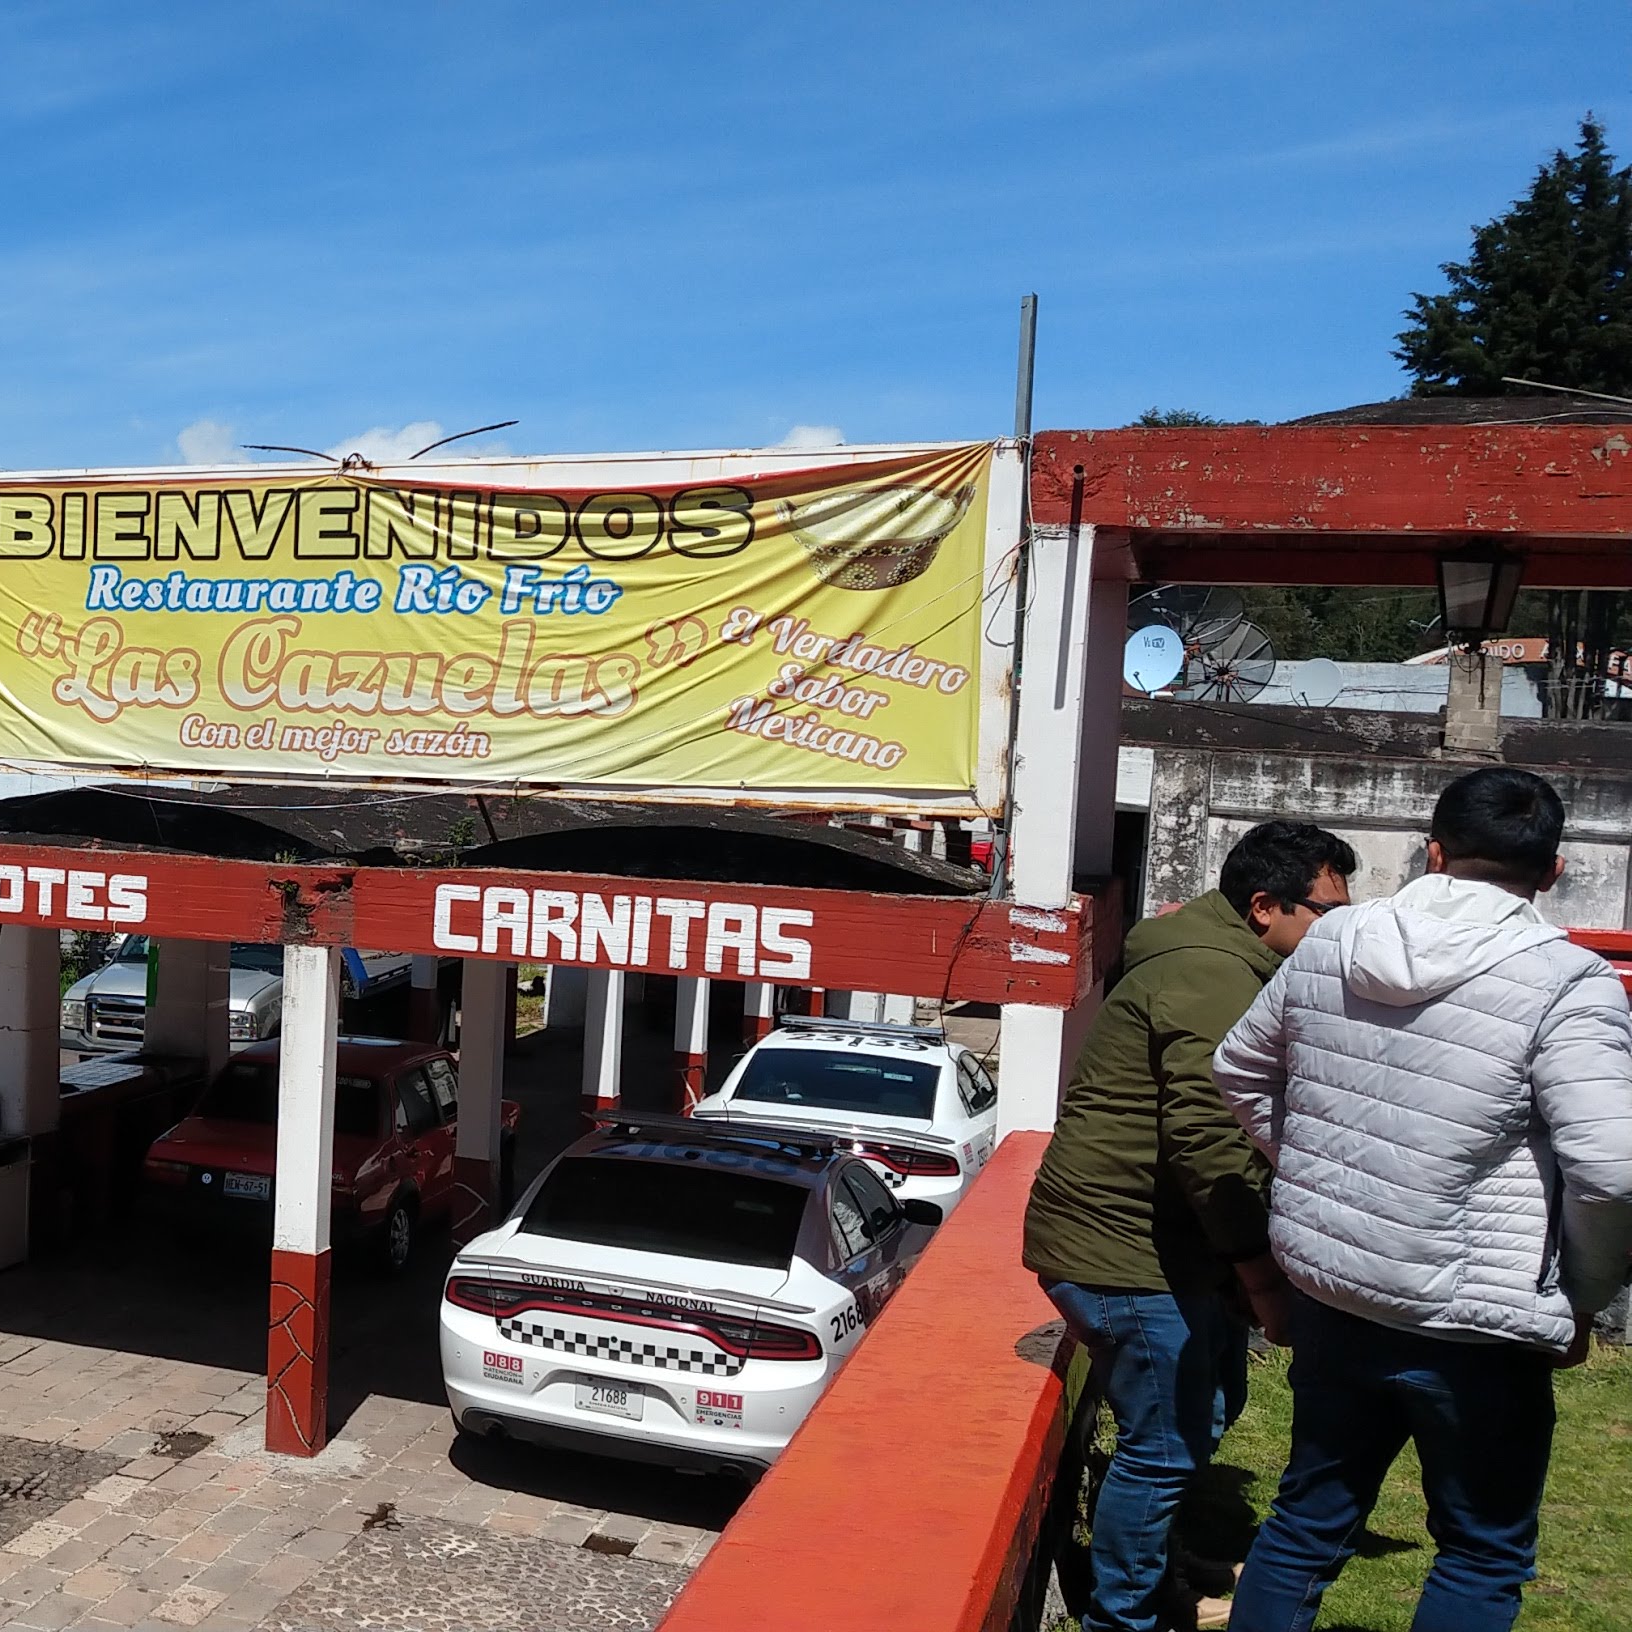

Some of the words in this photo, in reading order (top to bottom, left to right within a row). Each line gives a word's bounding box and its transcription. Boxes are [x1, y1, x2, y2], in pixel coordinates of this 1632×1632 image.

[86, 565, 382, 612] Restaurante
[394, 563, 492, 615] Río
[499, 563, 624, 615] Frío
[719, 605, 765, 648] El
[767, 611, 972, 695] Verdadero
[769, 664, 889, 720] Sabor
[179, 712, 240, 753] Con
[244, 714, 276, 750] el
[279, 716, 380, 763] mejor
[384, 721, 492, 759] sazón
[725, 694, 907, 771] Mexicano
[433, 884, 814, 980] CARNITAS
[521, 1273, 586, 1292] GUARDIA
[646, 1291, 717, 1313] NACIONAL
[483, 1373, 524, 1386] CIUDADANA
[485, 1352, 522, 1371] 088
[592, 1386, 627, 1405] 21688
[695, 1409, 743, 1421] EMERGENCIAS
[697, 1390, 742, 1410] 911
